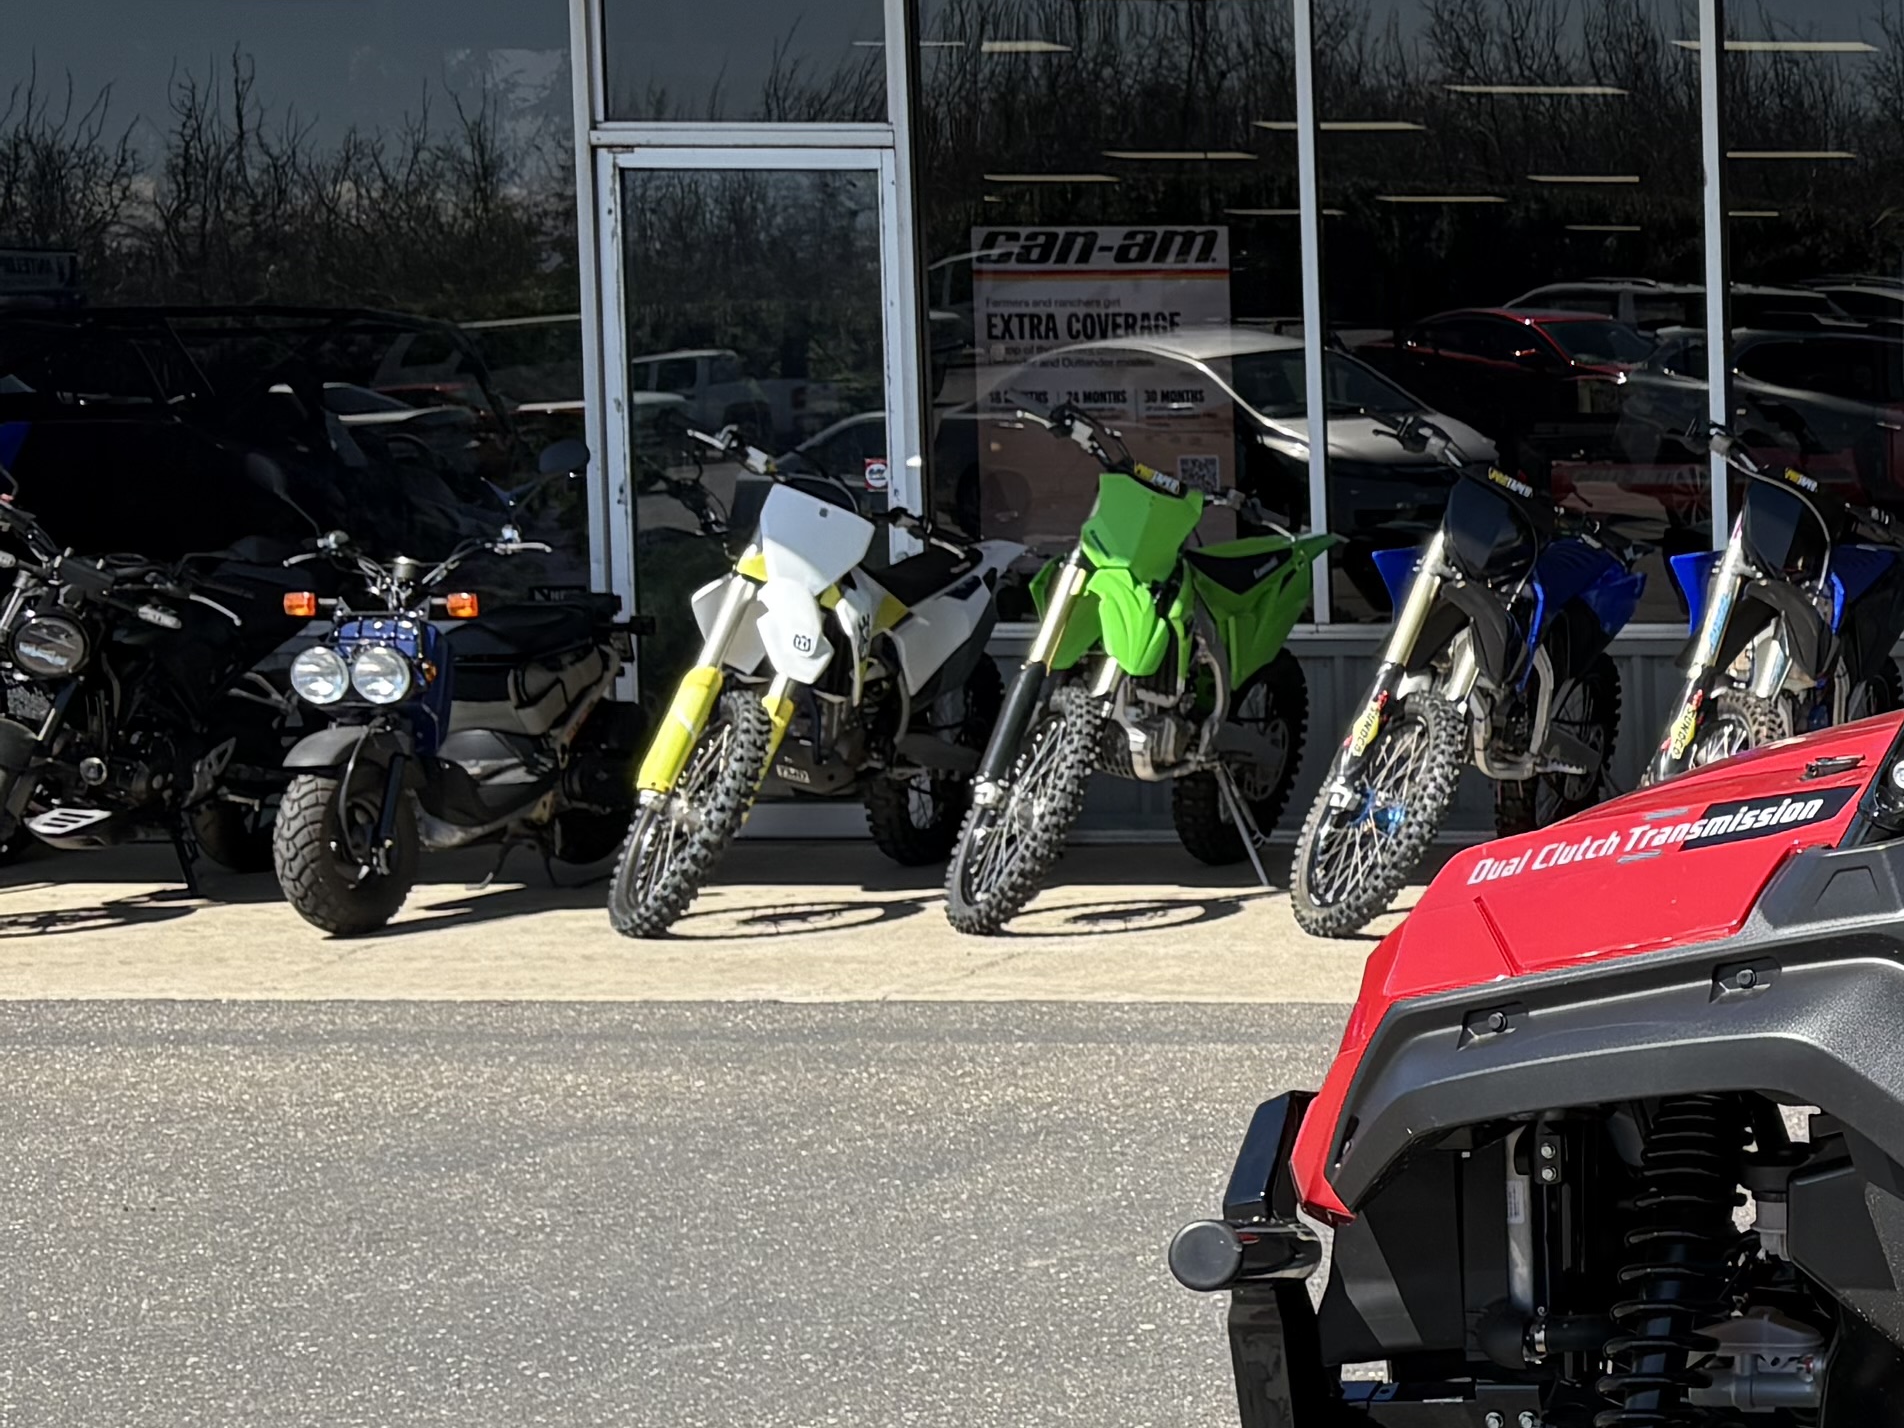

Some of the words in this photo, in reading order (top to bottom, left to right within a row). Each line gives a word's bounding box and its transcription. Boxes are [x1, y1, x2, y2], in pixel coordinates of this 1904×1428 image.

[986, 312, 1058, 340] EXTRA
[1067, 311, 1181, 341] COVERAGE
[1082, 389, 1127, 404] MONTHS
[1160, 389, 1205, 403] MONTHS
[1672, 708, 1695, 755] SUNOCO
[1466, 855, 1528, 885] Dual
[1531, 831, 1619, 871] Clutch
[1620, 797, 1824, 853] Transmission
